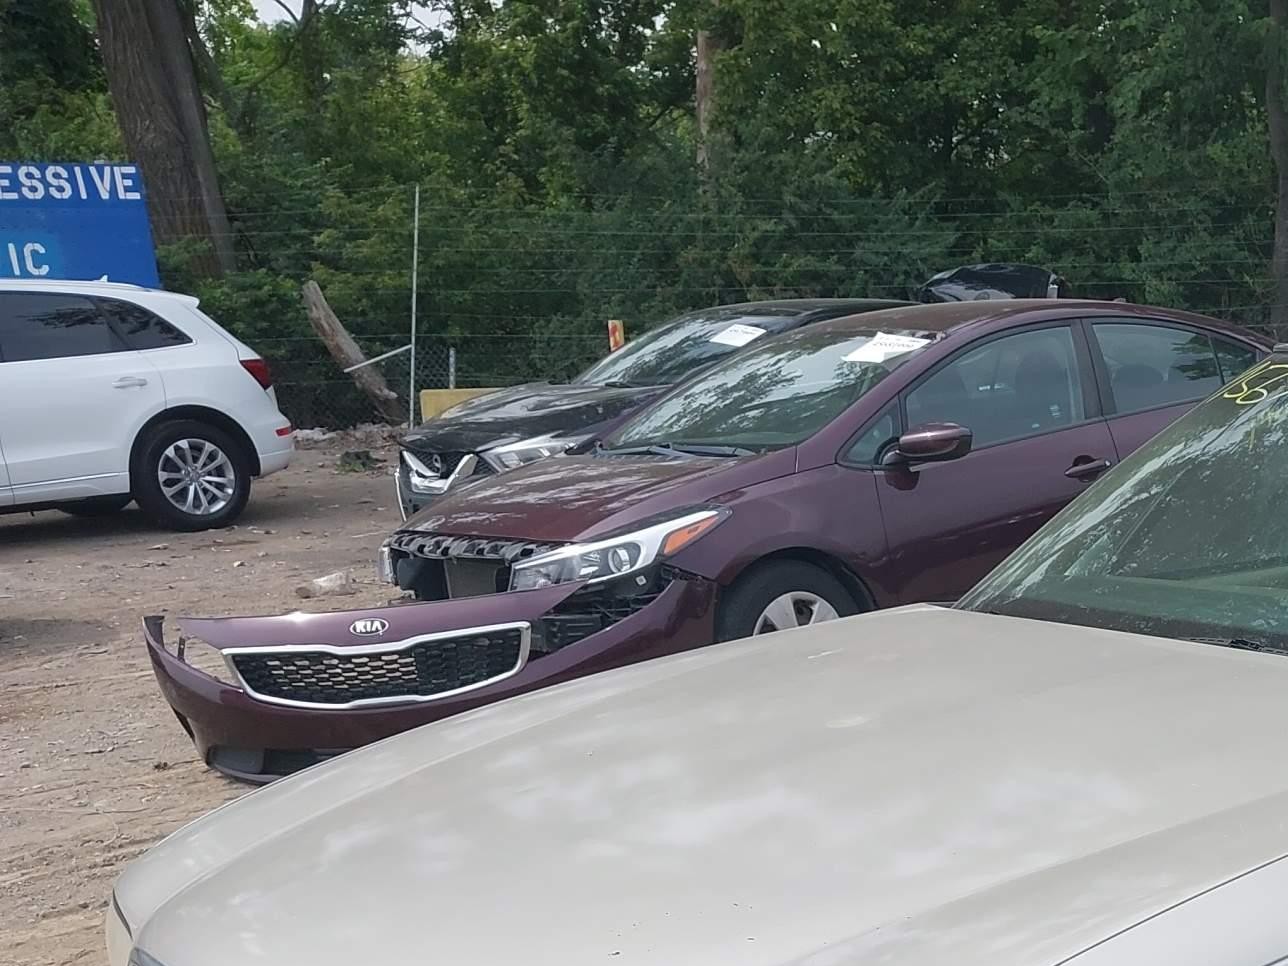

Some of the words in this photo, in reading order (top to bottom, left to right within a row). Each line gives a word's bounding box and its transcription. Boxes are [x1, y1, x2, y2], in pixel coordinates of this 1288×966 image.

[0, 165, 141, 200] ESSIVE
[7, 242, 50, 276] IC
[353, 619, 384, 634] KIA
